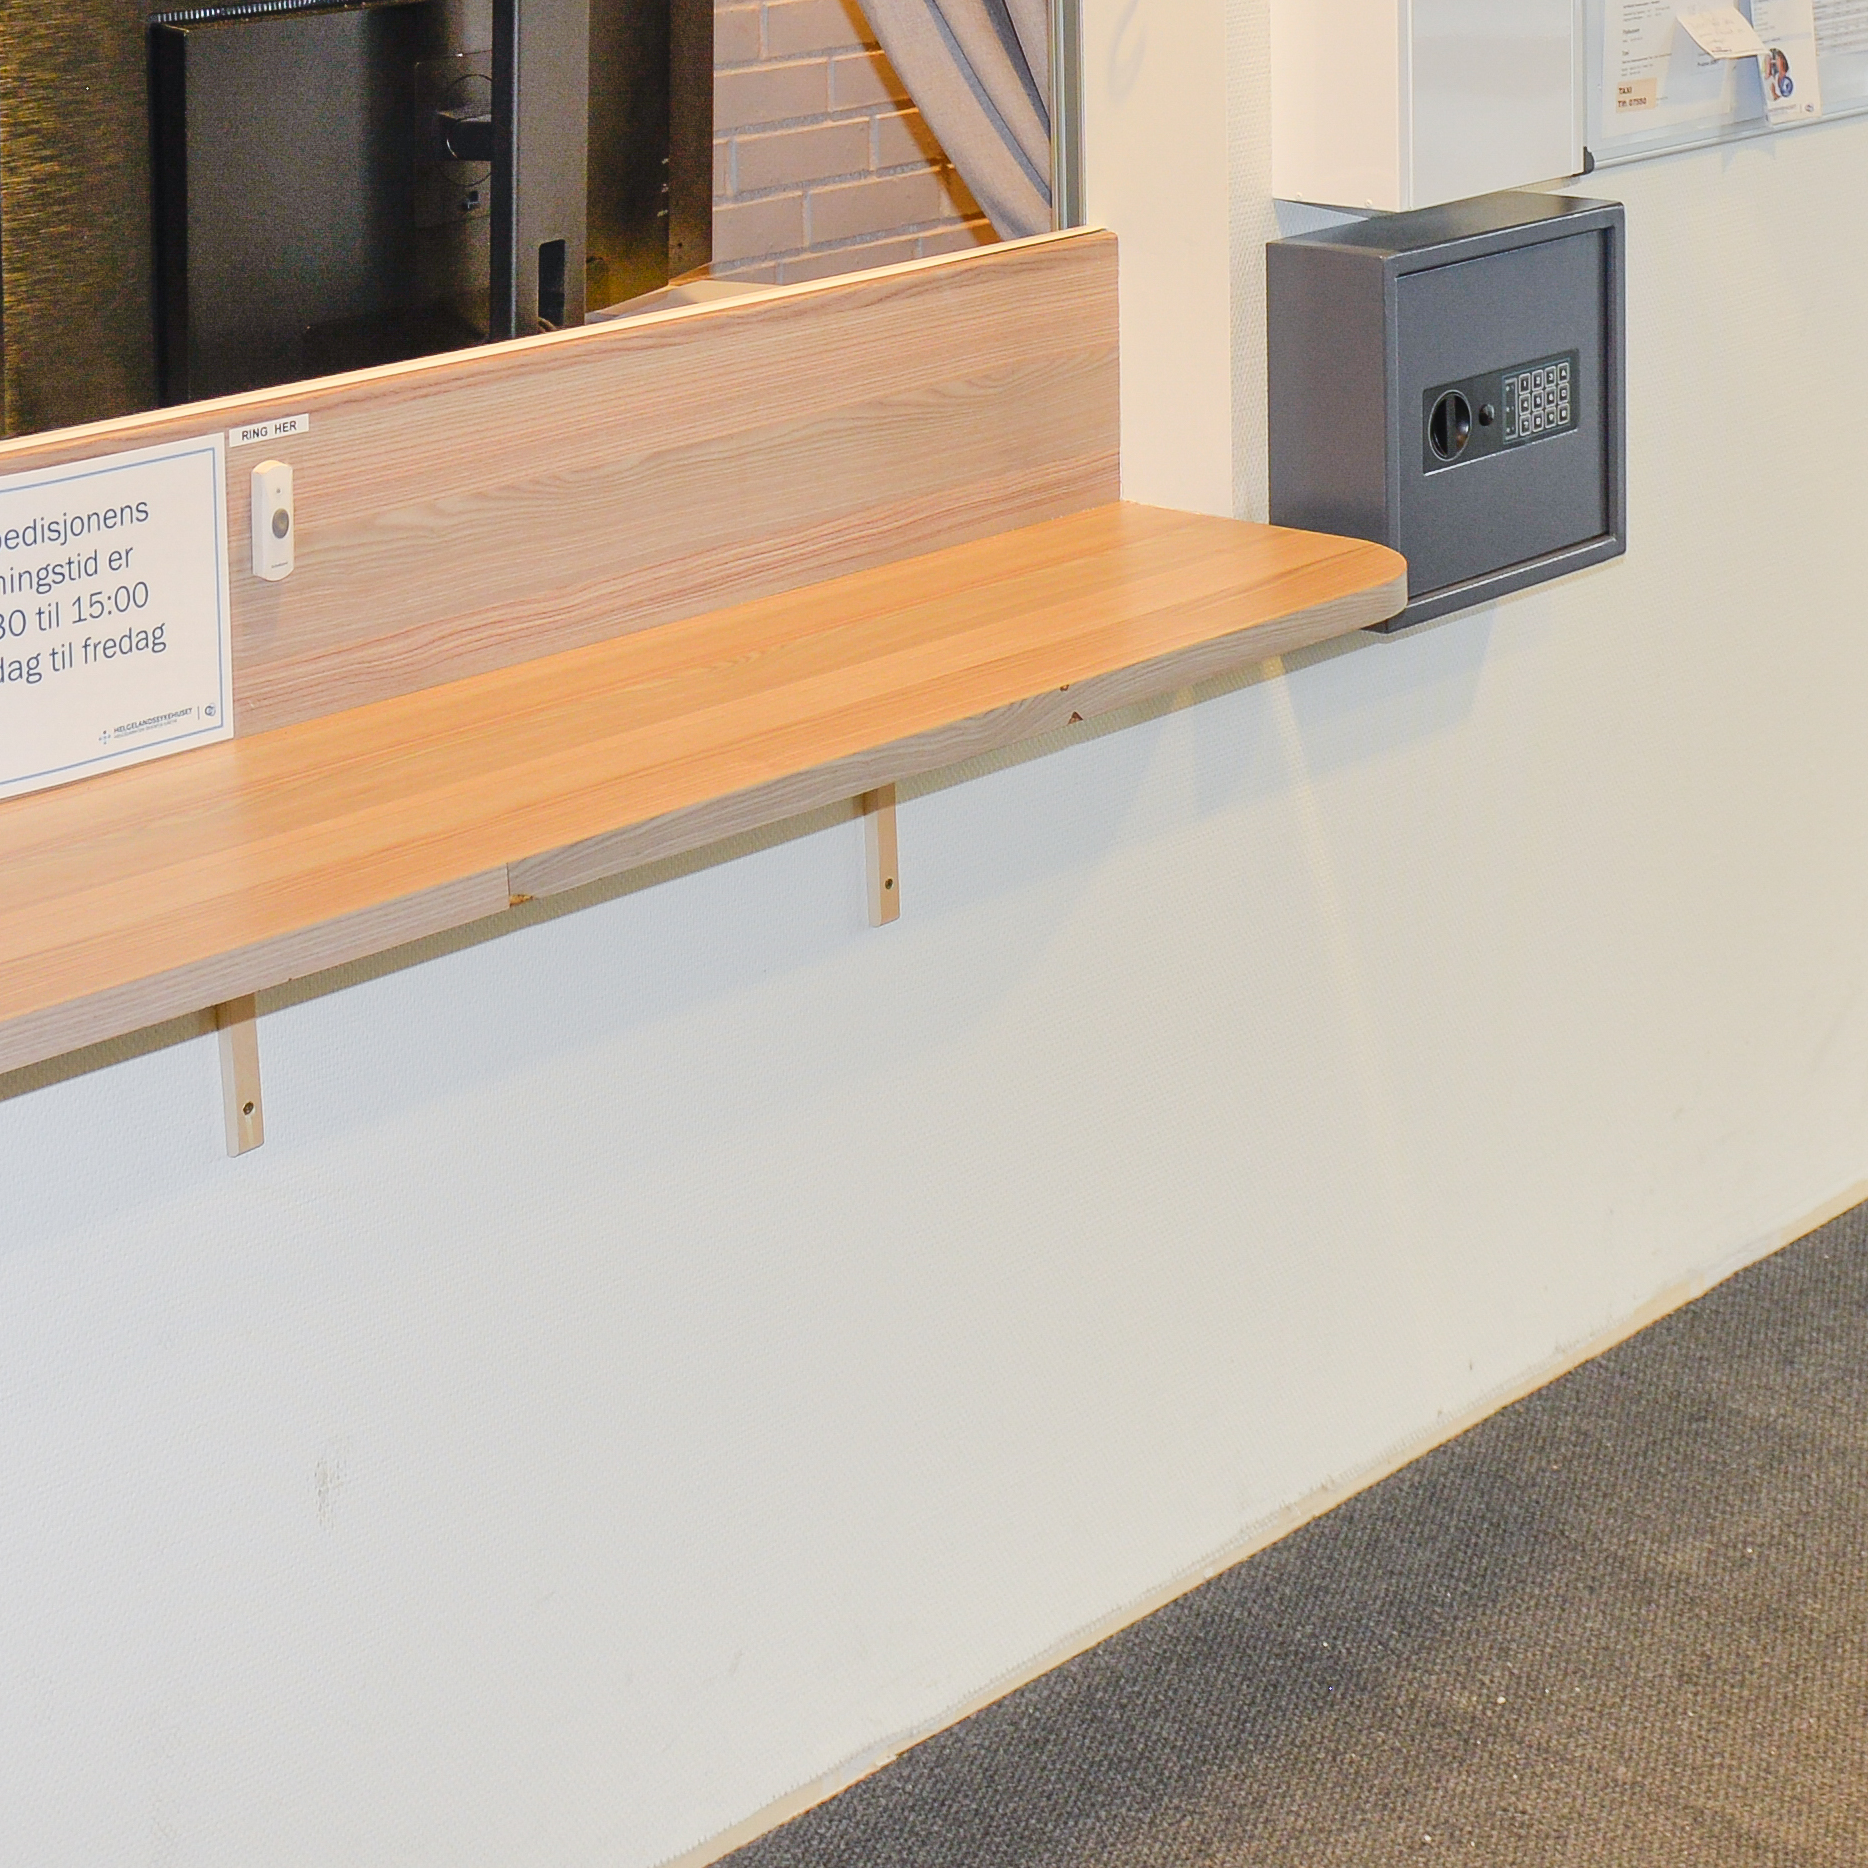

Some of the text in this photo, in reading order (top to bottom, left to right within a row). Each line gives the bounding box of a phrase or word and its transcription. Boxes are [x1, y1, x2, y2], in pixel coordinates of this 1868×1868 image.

[242, 420, 296, 440] RING HER
[108, 545, 134, 571] er
[35, 604, 61, 633] til
[70, 581, 150, 625] 15:00
[49, 643, 74, 673] til
[82, 620, 167, 665] fredag
